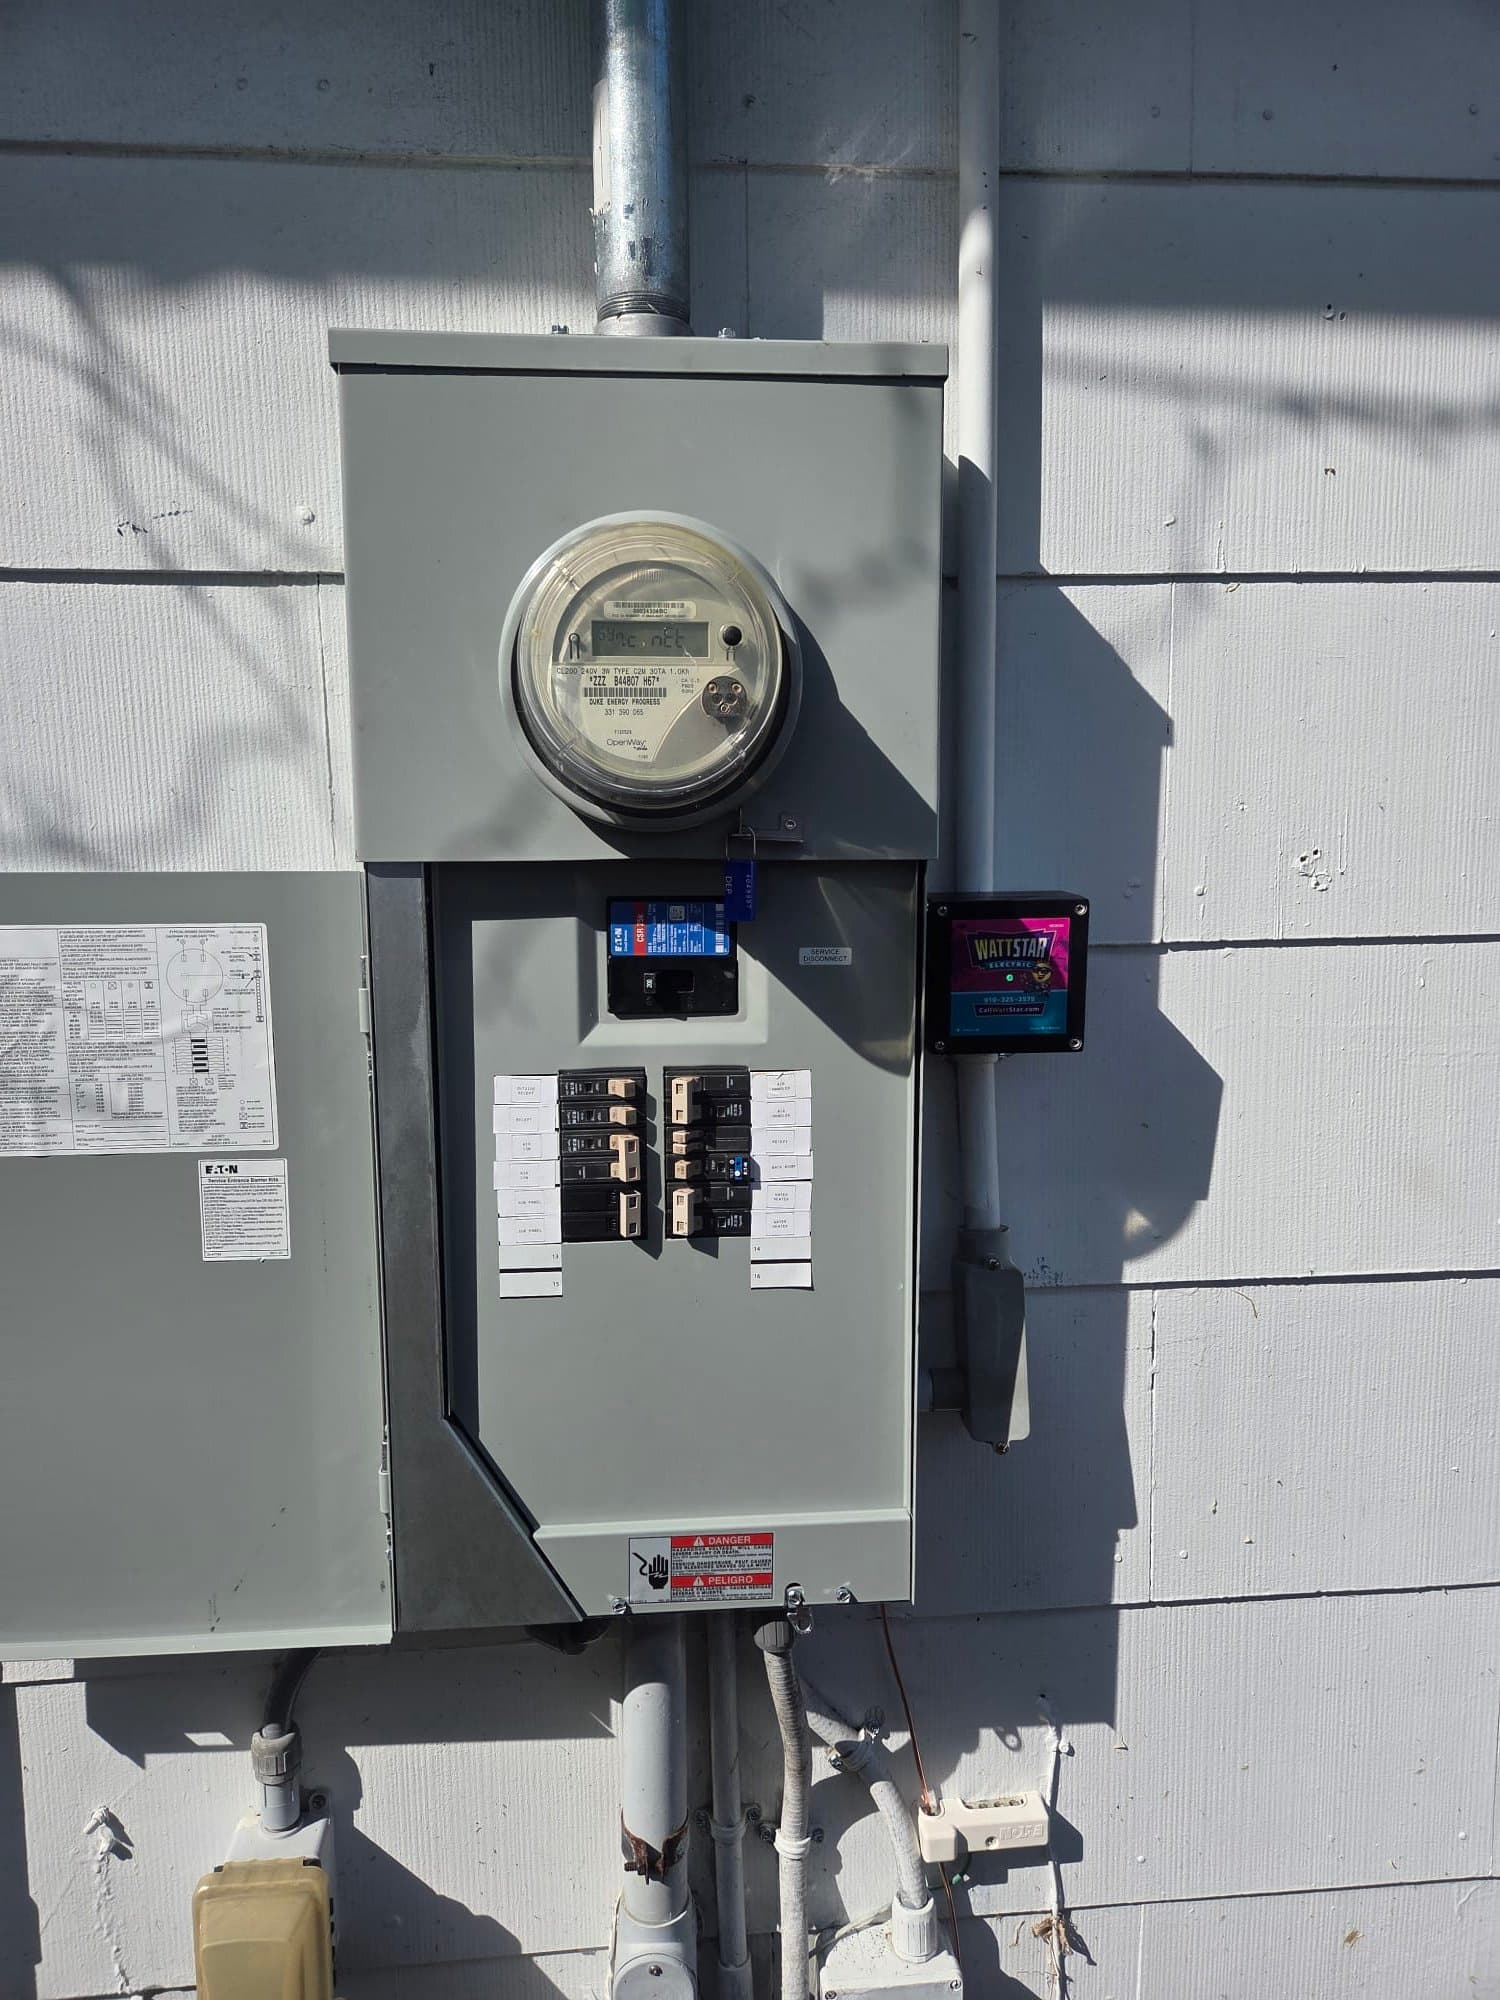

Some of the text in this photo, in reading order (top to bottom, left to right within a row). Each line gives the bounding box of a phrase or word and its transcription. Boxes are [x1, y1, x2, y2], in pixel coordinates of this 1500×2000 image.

[974, 937, 1048, 960] WATTSTAR
[708, 1536, 751, 1545] DANGER
[708, 1576, 753, 1585] PELIGRO
